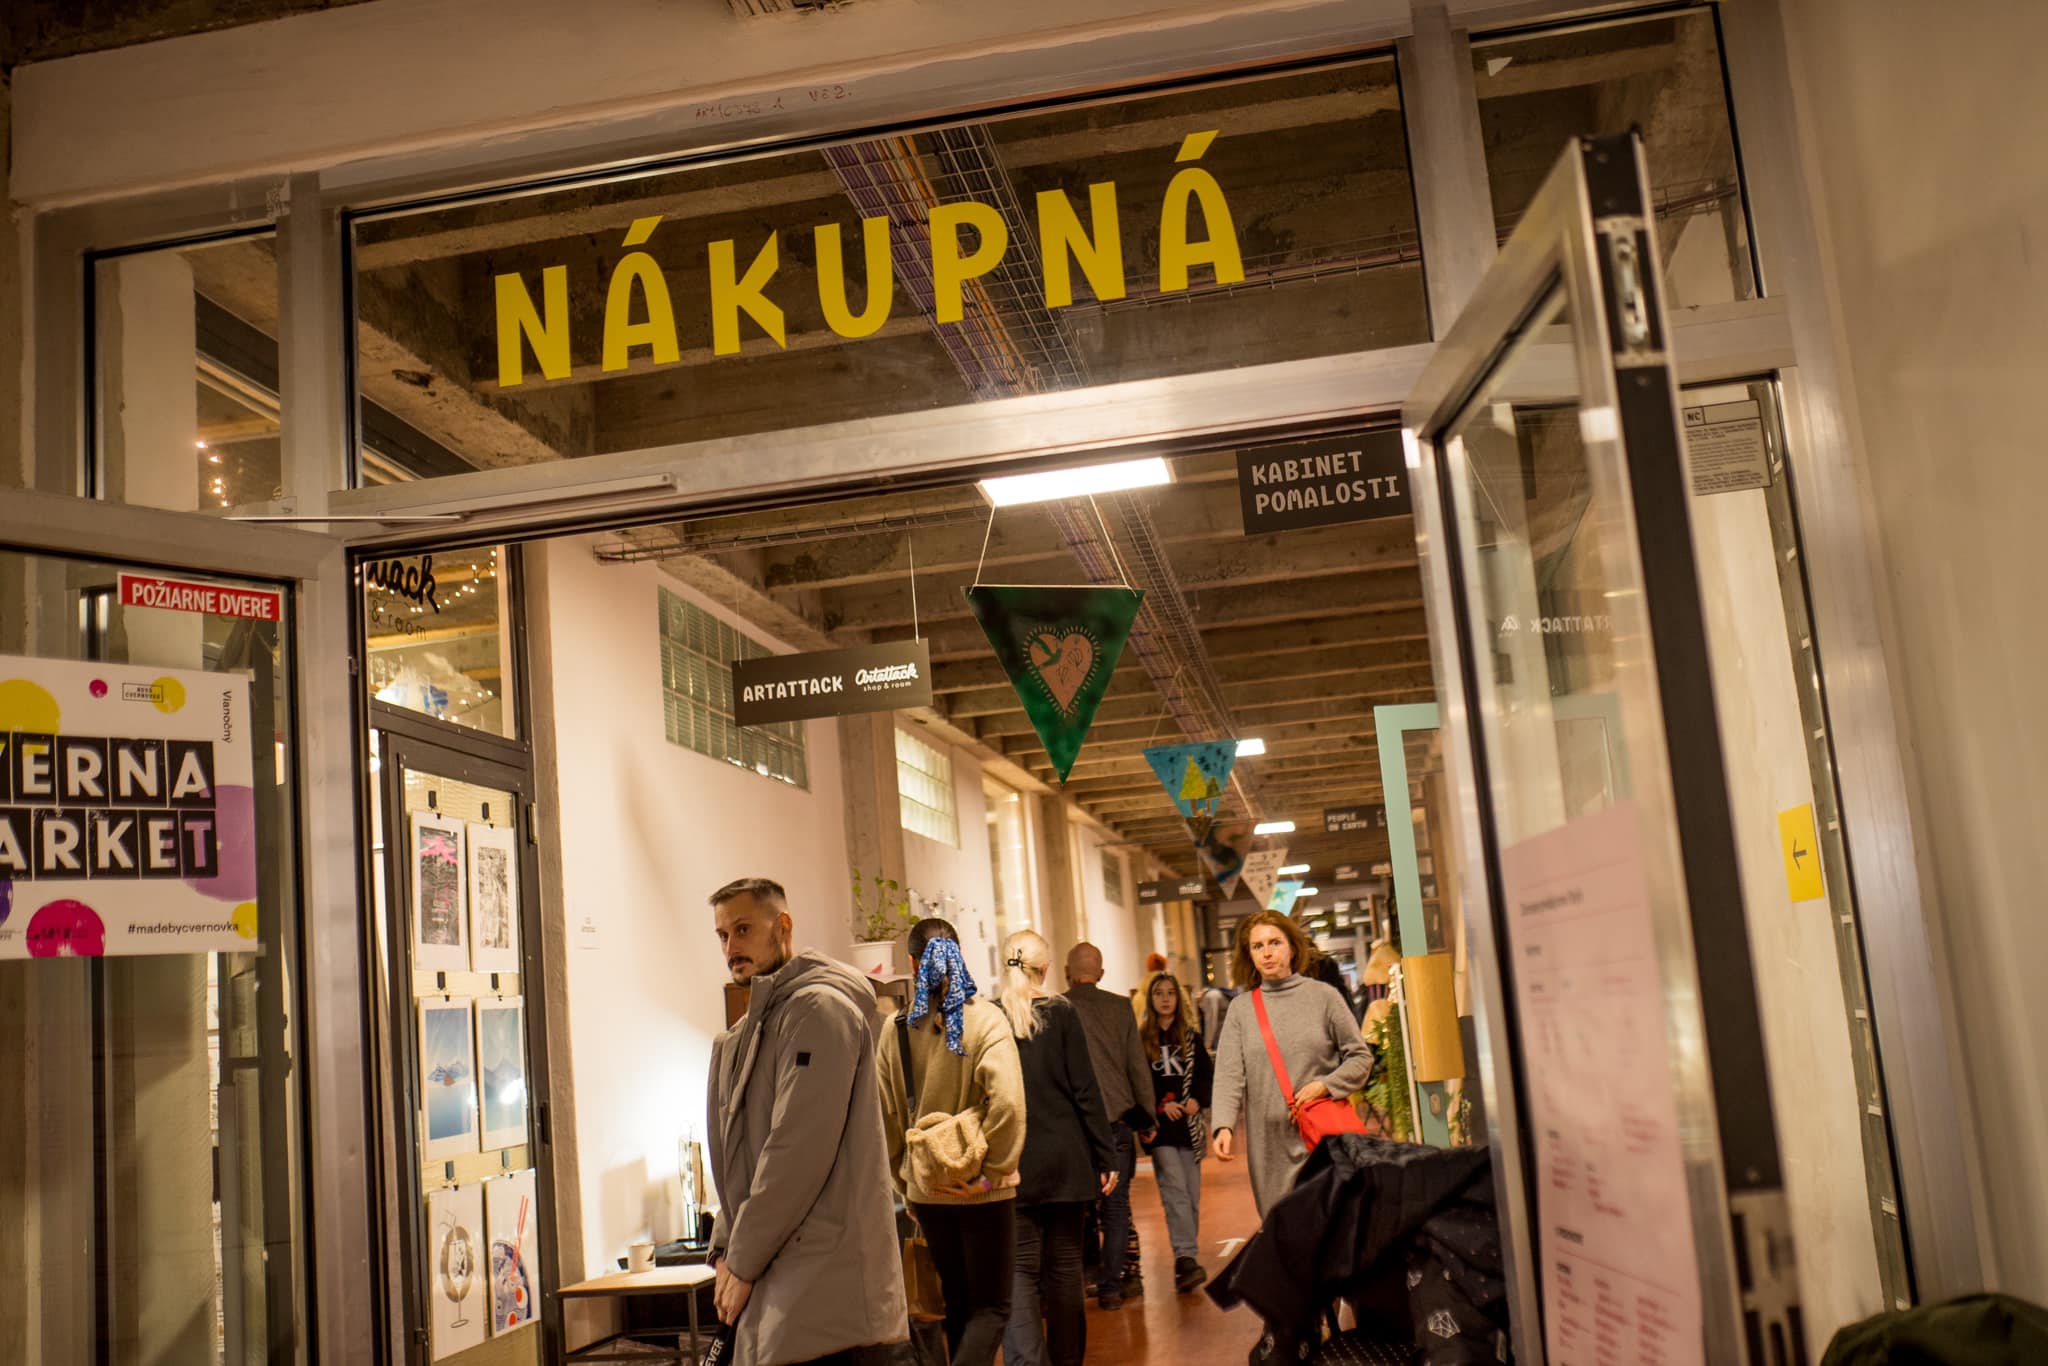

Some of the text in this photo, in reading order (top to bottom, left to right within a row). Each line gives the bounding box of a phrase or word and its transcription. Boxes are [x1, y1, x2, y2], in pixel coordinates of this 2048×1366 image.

[495, 129, 1245, 387] NÁKUPNÁ
[1251, 450, 1363, 487] KABINET
[1255, 475, 1400, 515] POMALOSTI
[132, 580, 272, 619] POŽIARNE DVERE
[387, 614, 427, 641] room
[743, 675, 843, 703] ARTATTACK
[0, 742, 212, 799] ERNA
[128, 921, 239, 936] #madebycvernovka
